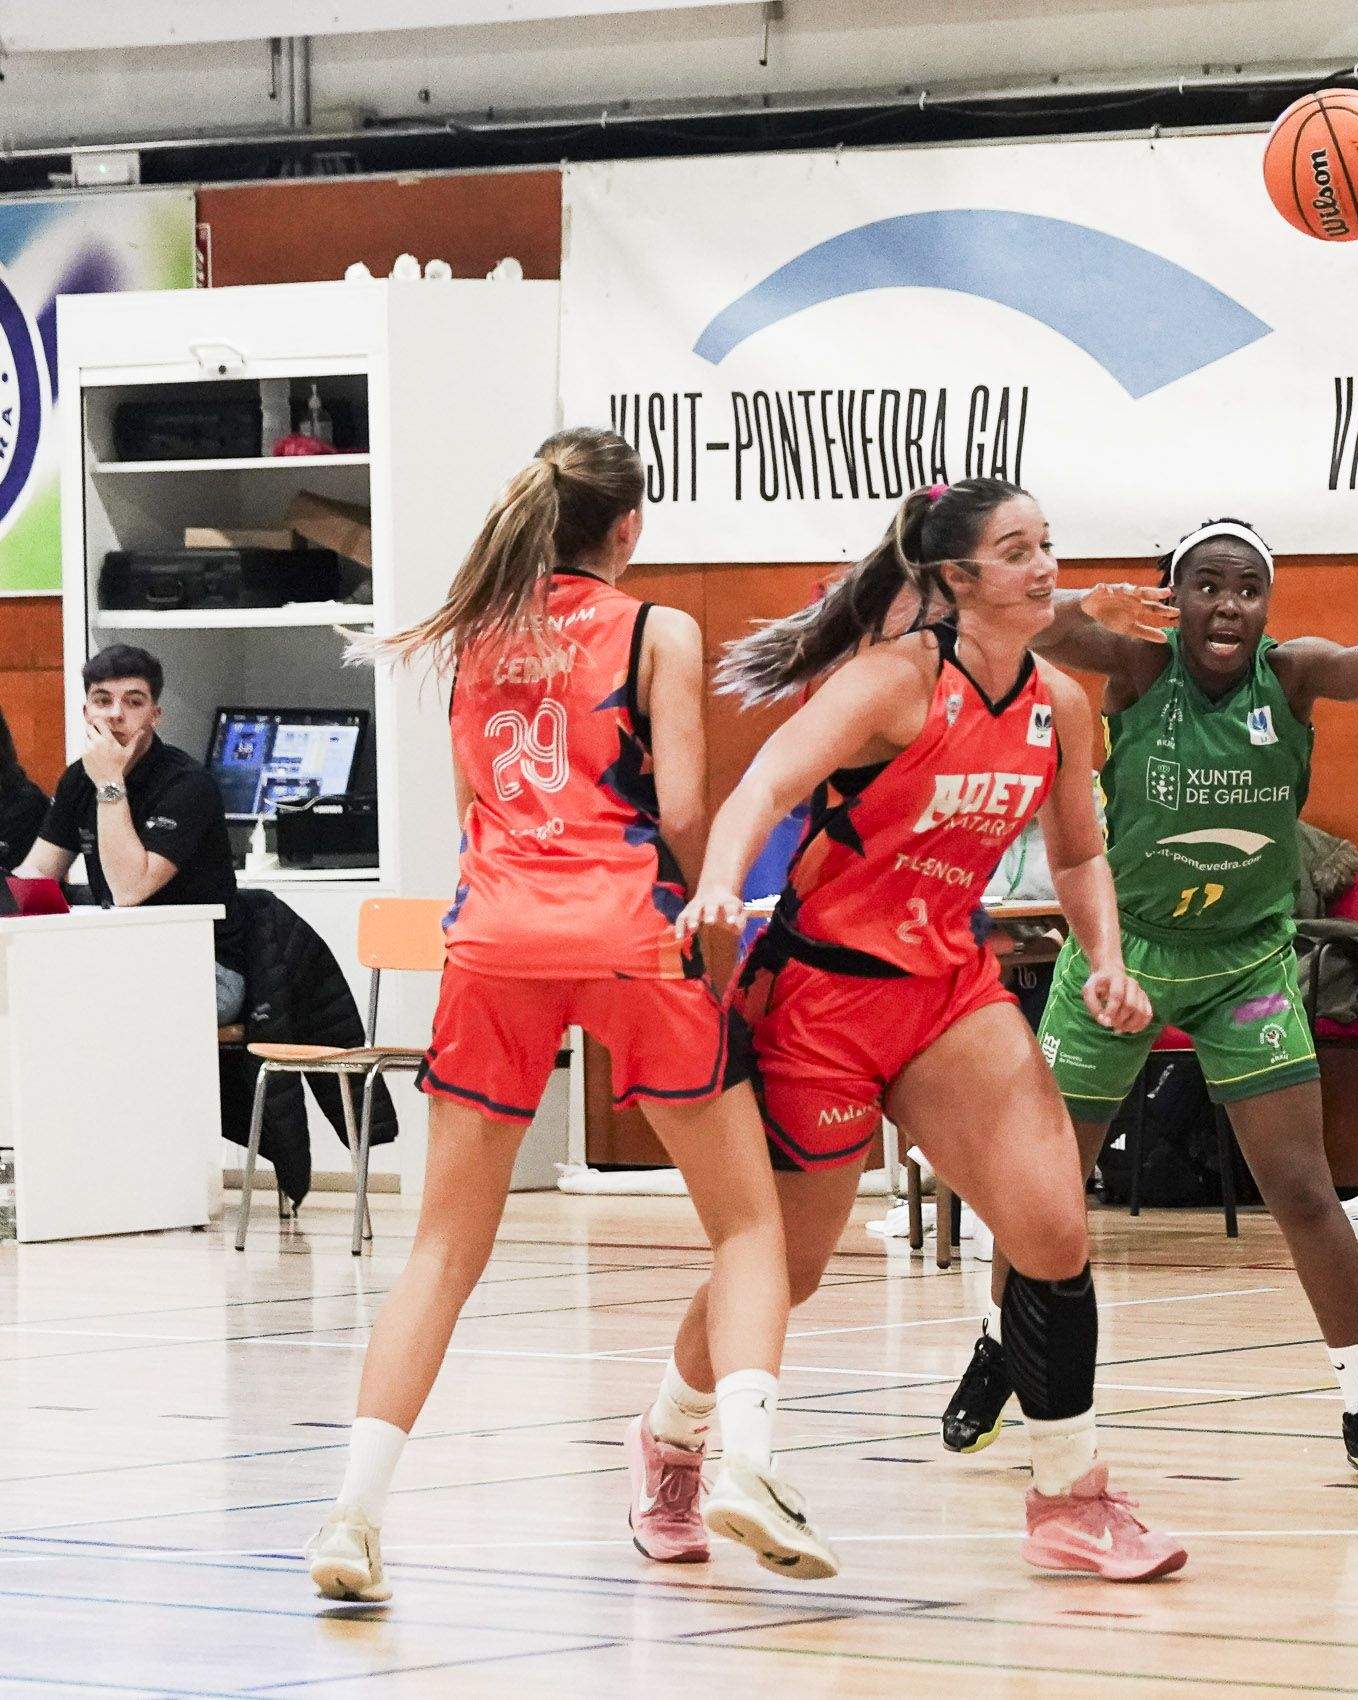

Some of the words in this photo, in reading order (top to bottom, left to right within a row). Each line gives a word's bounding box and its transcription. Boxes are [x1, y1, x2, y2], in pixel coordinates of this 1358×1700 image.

[1310, 148, 1350, 237] Wilson
[484, 697, 569, 801] 29
[1186, 768, 1253, 787] XUNTA
[1186, 787, 1211, 805] DE
[1214, 785, 1291, 806] GALICIA
[897, 897, 928, 944] 2
